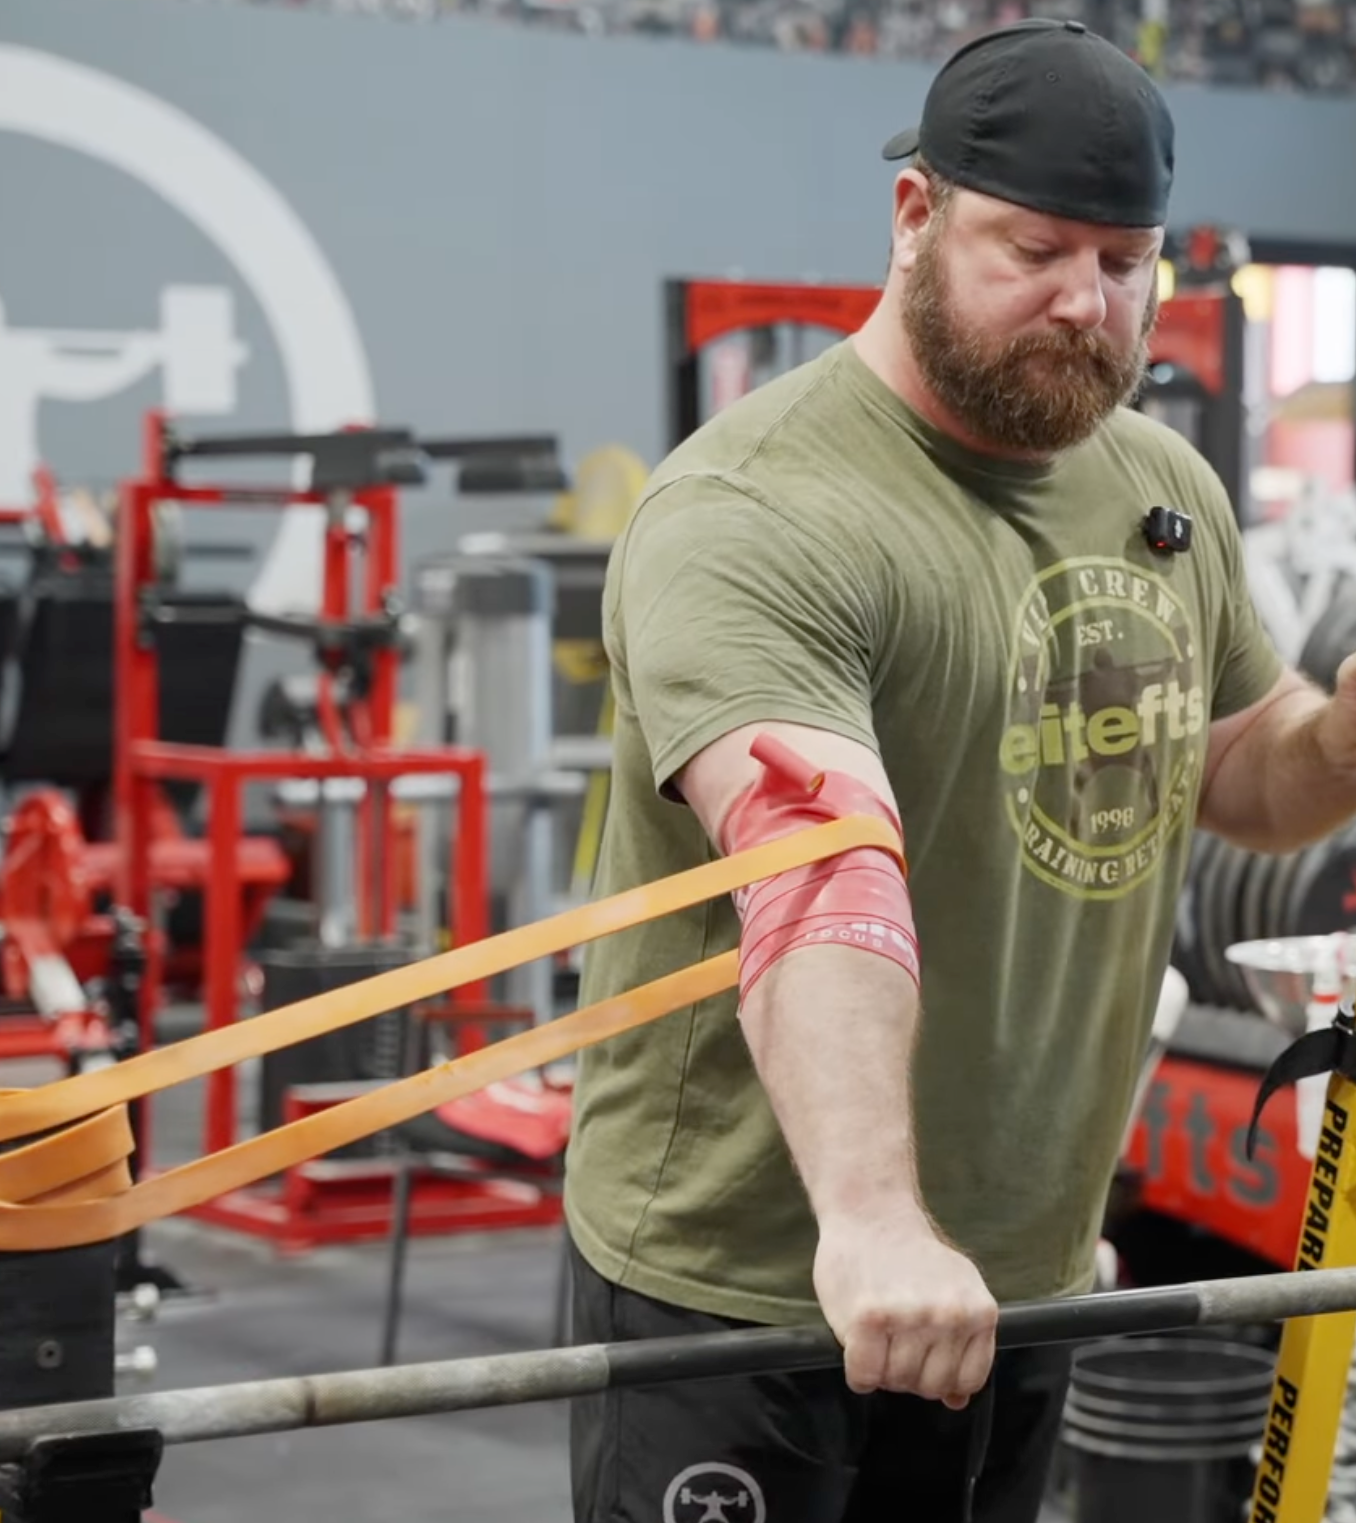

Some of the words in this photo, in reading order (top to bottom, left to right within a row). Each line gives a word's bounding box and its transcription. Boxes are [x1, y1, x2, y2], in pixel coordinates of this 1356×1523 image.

[1078, 567, 1178, 624] CREW
[1077, 619, 1125, 646] EST.
[999, 680, 1204, 775] eitefts
[1089, 806, 1135, 835] 1998
[1025, 822, 1120, 884] RAINING
